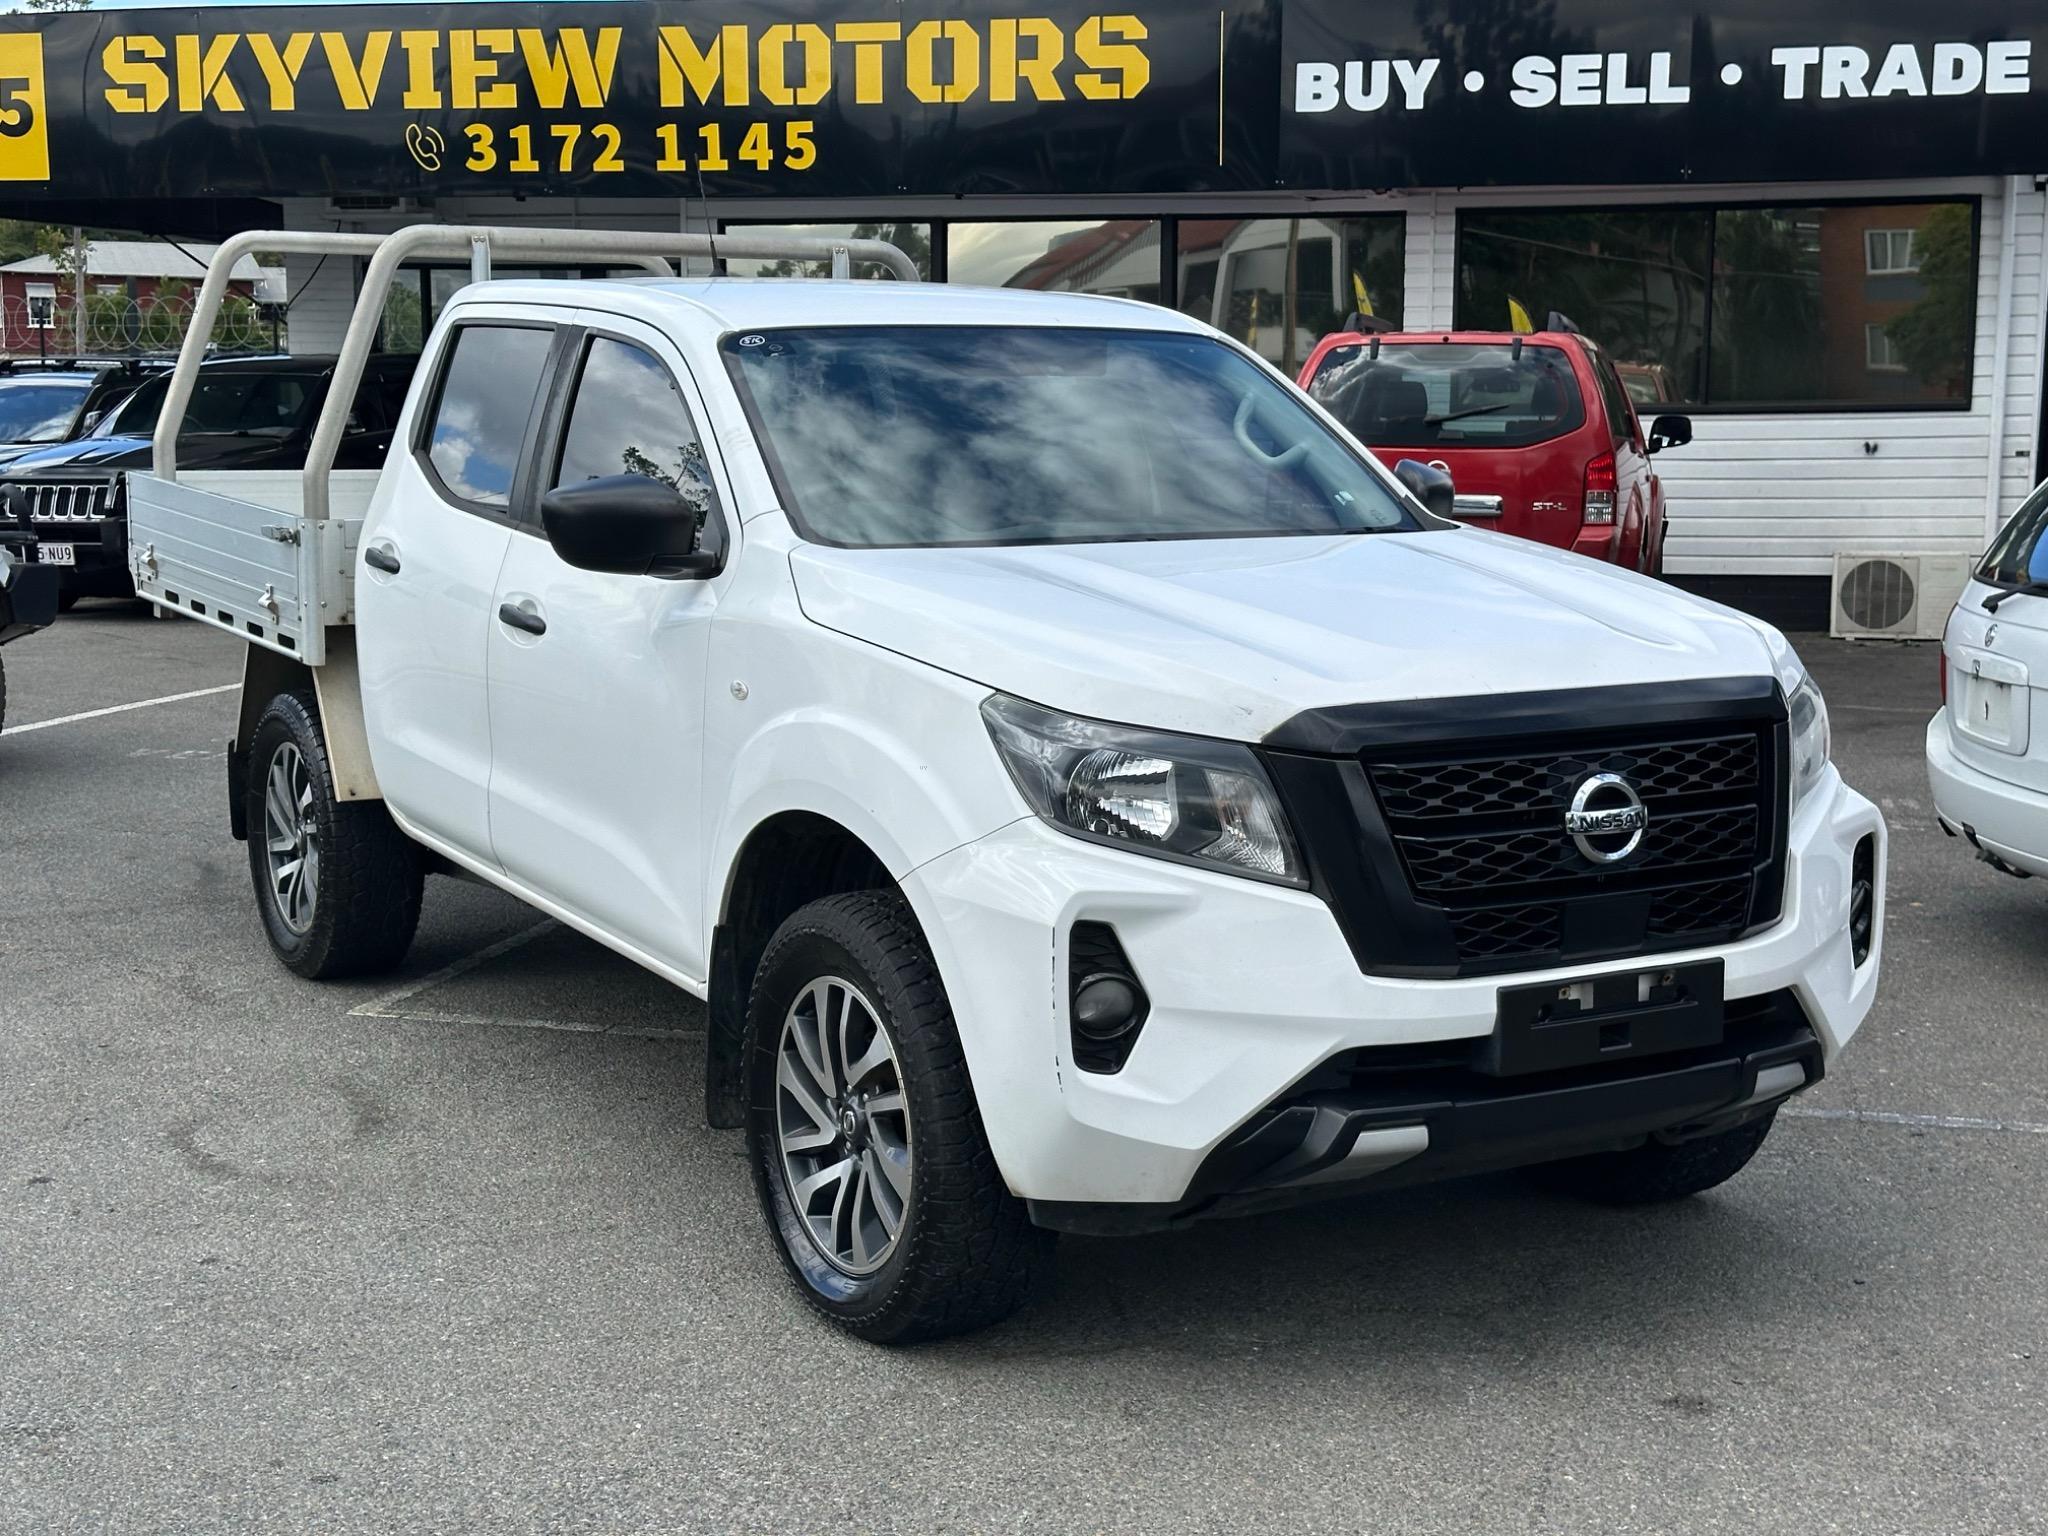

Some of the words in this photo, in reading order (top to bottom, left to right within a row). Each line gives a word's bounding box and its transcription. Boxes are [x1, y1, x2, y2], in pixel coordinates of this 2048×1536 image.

[102, 27, 622, 112] SKYVIEW
[658, 15, 1149, 107] MOTORS
[1295, 58, 1440, 113] BUY
[1510, 52, 1691, 108] SELL
[1771, 40, 2031, 100] TRADE
[465, 123, 625, 173] 3172
[656, 120, 817, 172] 1145
[1579, 811, 1646, 832] NISSAN
